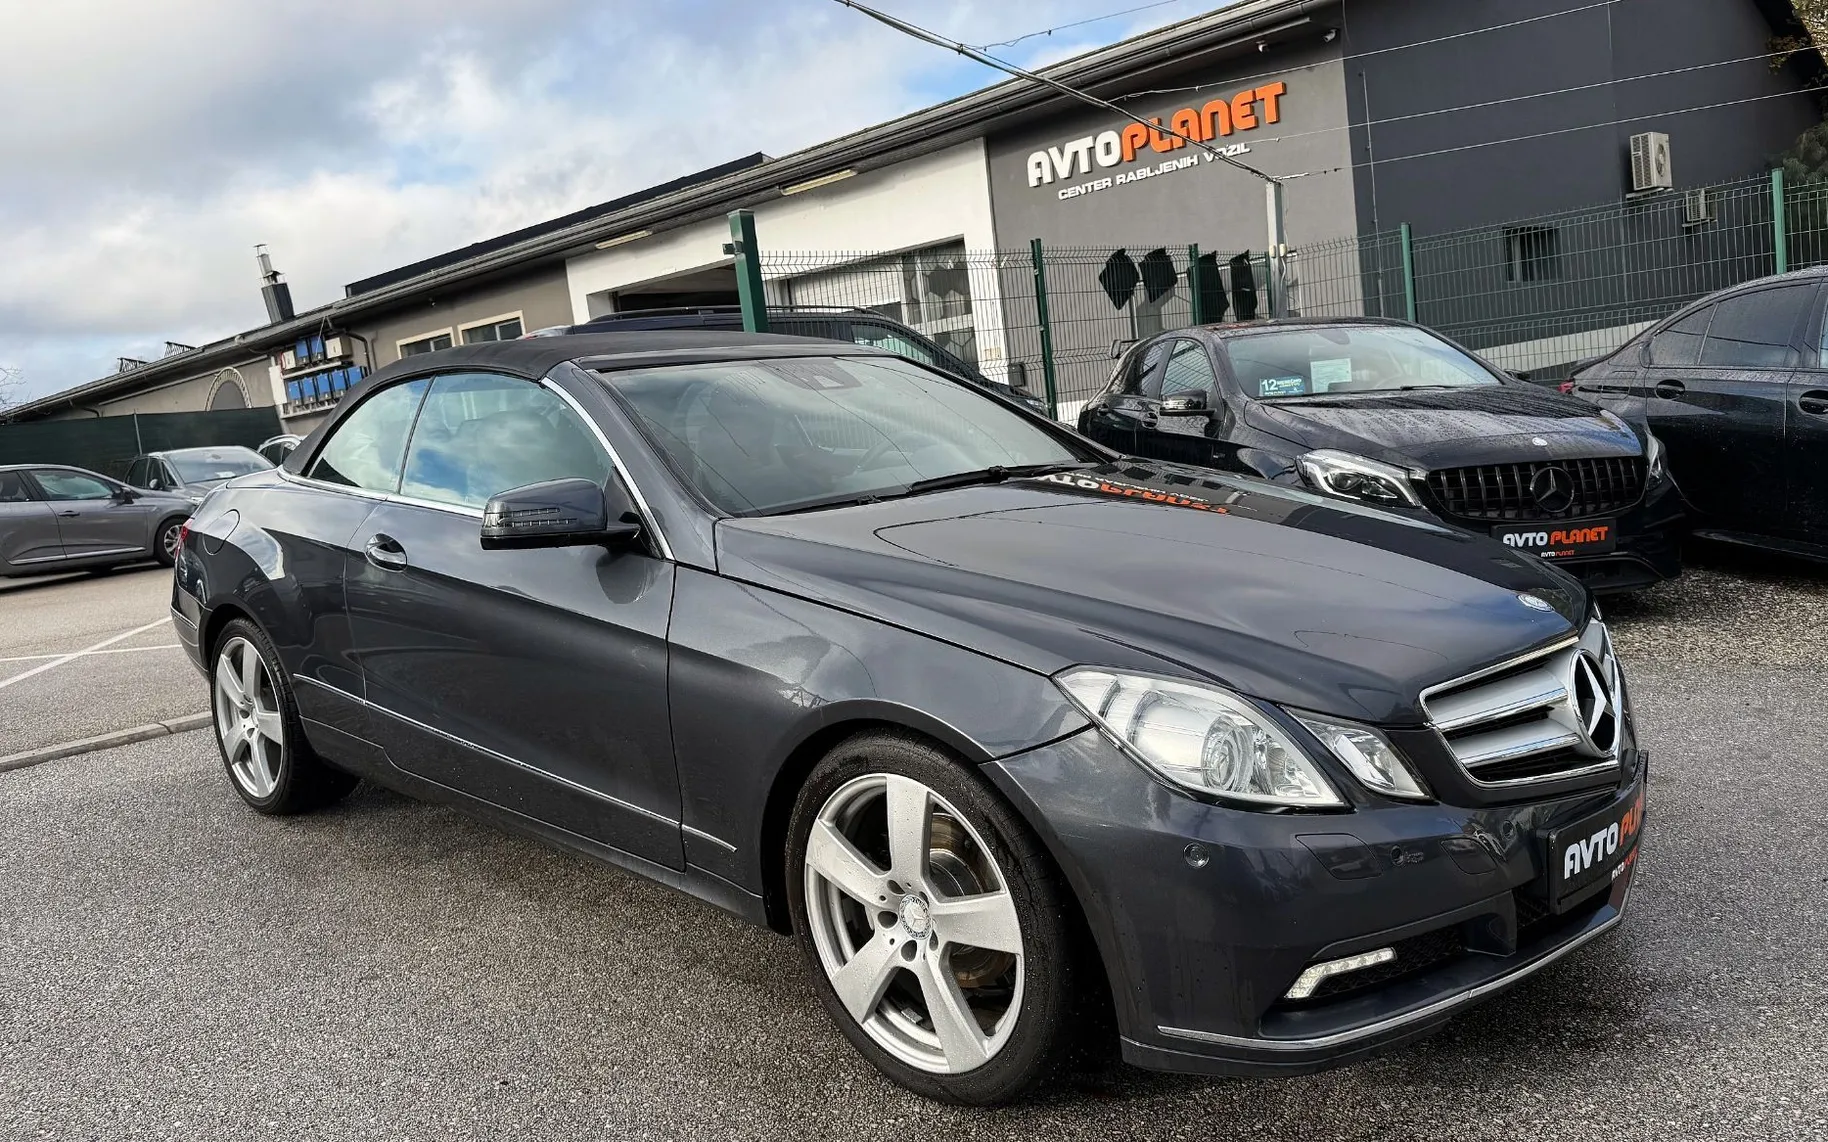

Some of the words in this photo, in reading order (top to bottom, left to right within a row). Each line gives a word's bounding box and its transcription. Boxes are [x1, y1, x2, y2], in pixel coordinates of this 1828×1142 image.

[1058, 177, 1112, 201] CENTER
[1116, 153, 1199, 186] RABLJENIH
[1261, 379, 1278, 391] 12
[1502, 531, 1548, 548] AVTO
[1550, 526, 1609, 545] PLANET
[1564, 822, 1619, 880] AVTO
